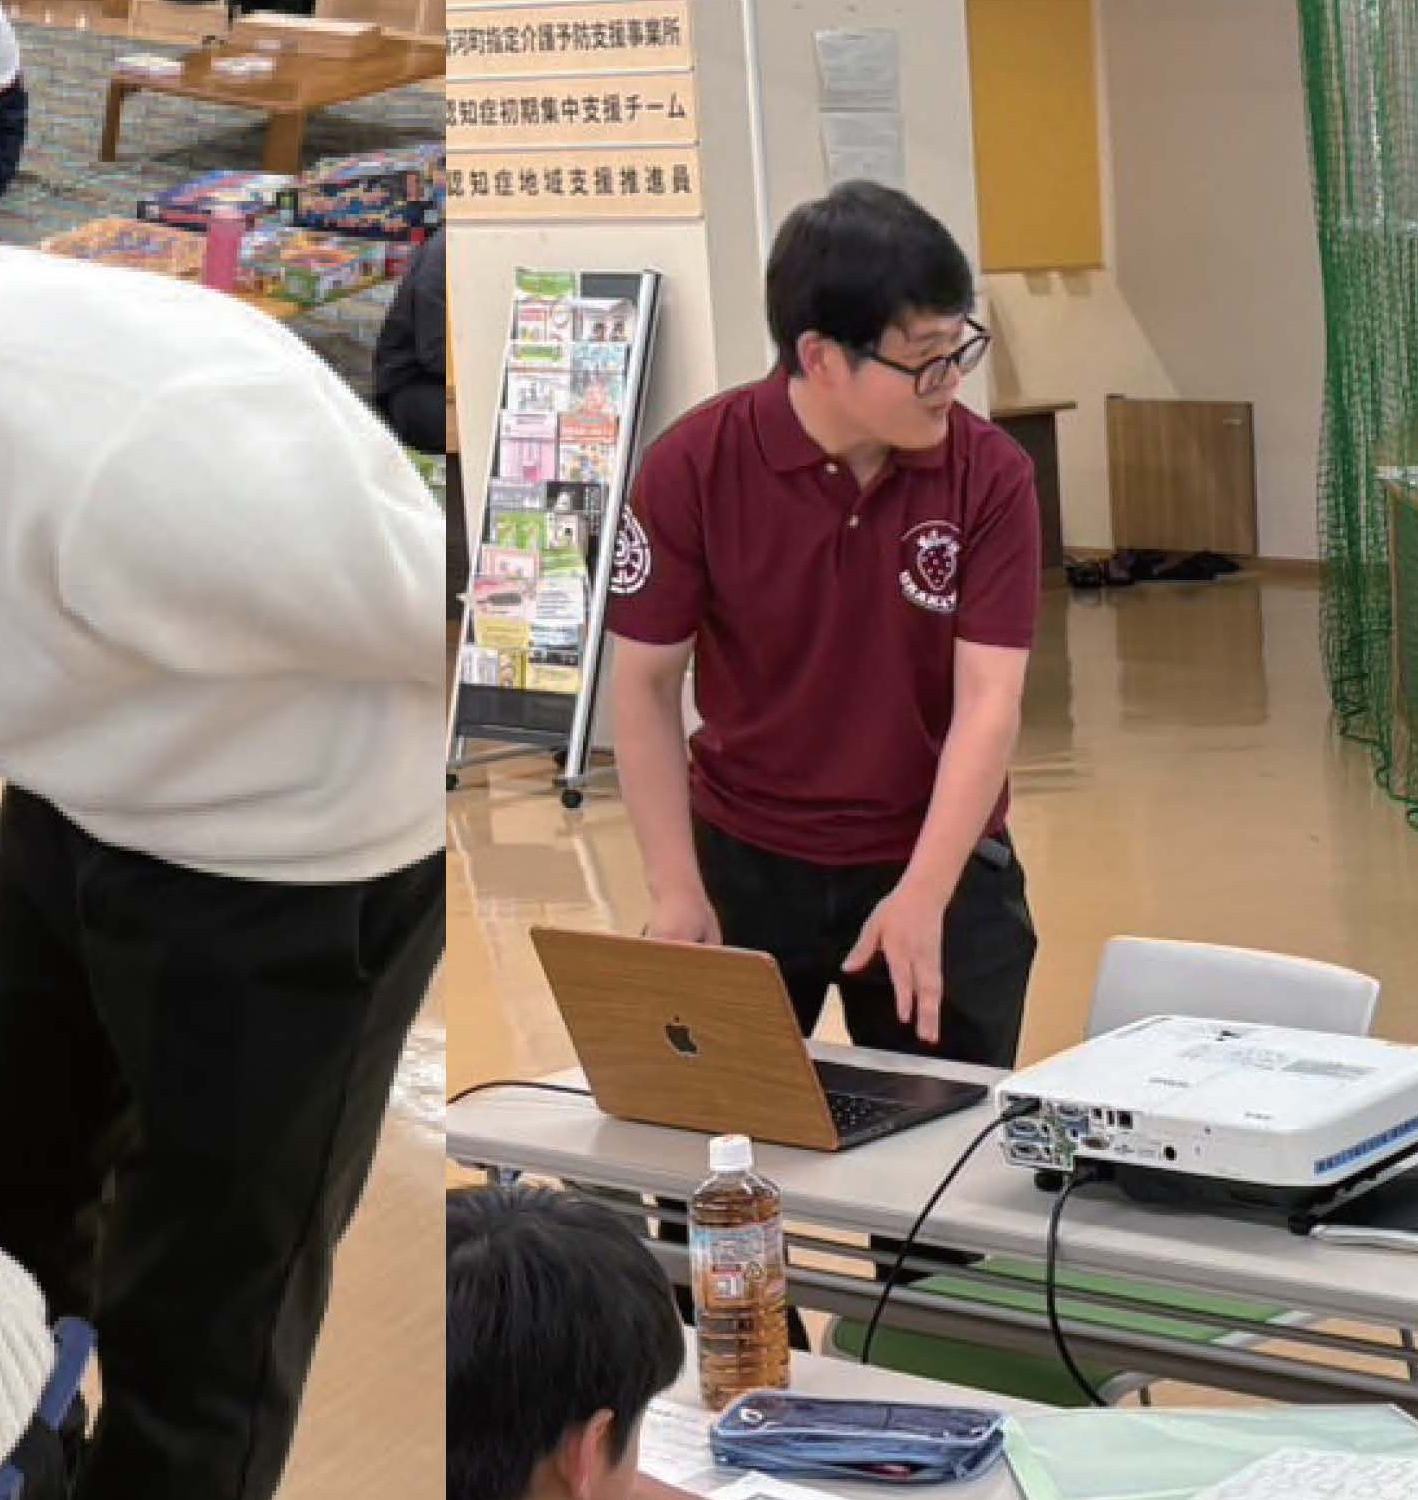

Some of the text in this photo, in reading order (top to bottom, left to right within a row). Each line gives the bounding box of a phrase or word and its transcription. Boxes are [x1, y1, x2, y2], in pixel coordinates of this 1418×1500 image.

[446, 16, 680, 56] 河町指定介護予防支援事業所
